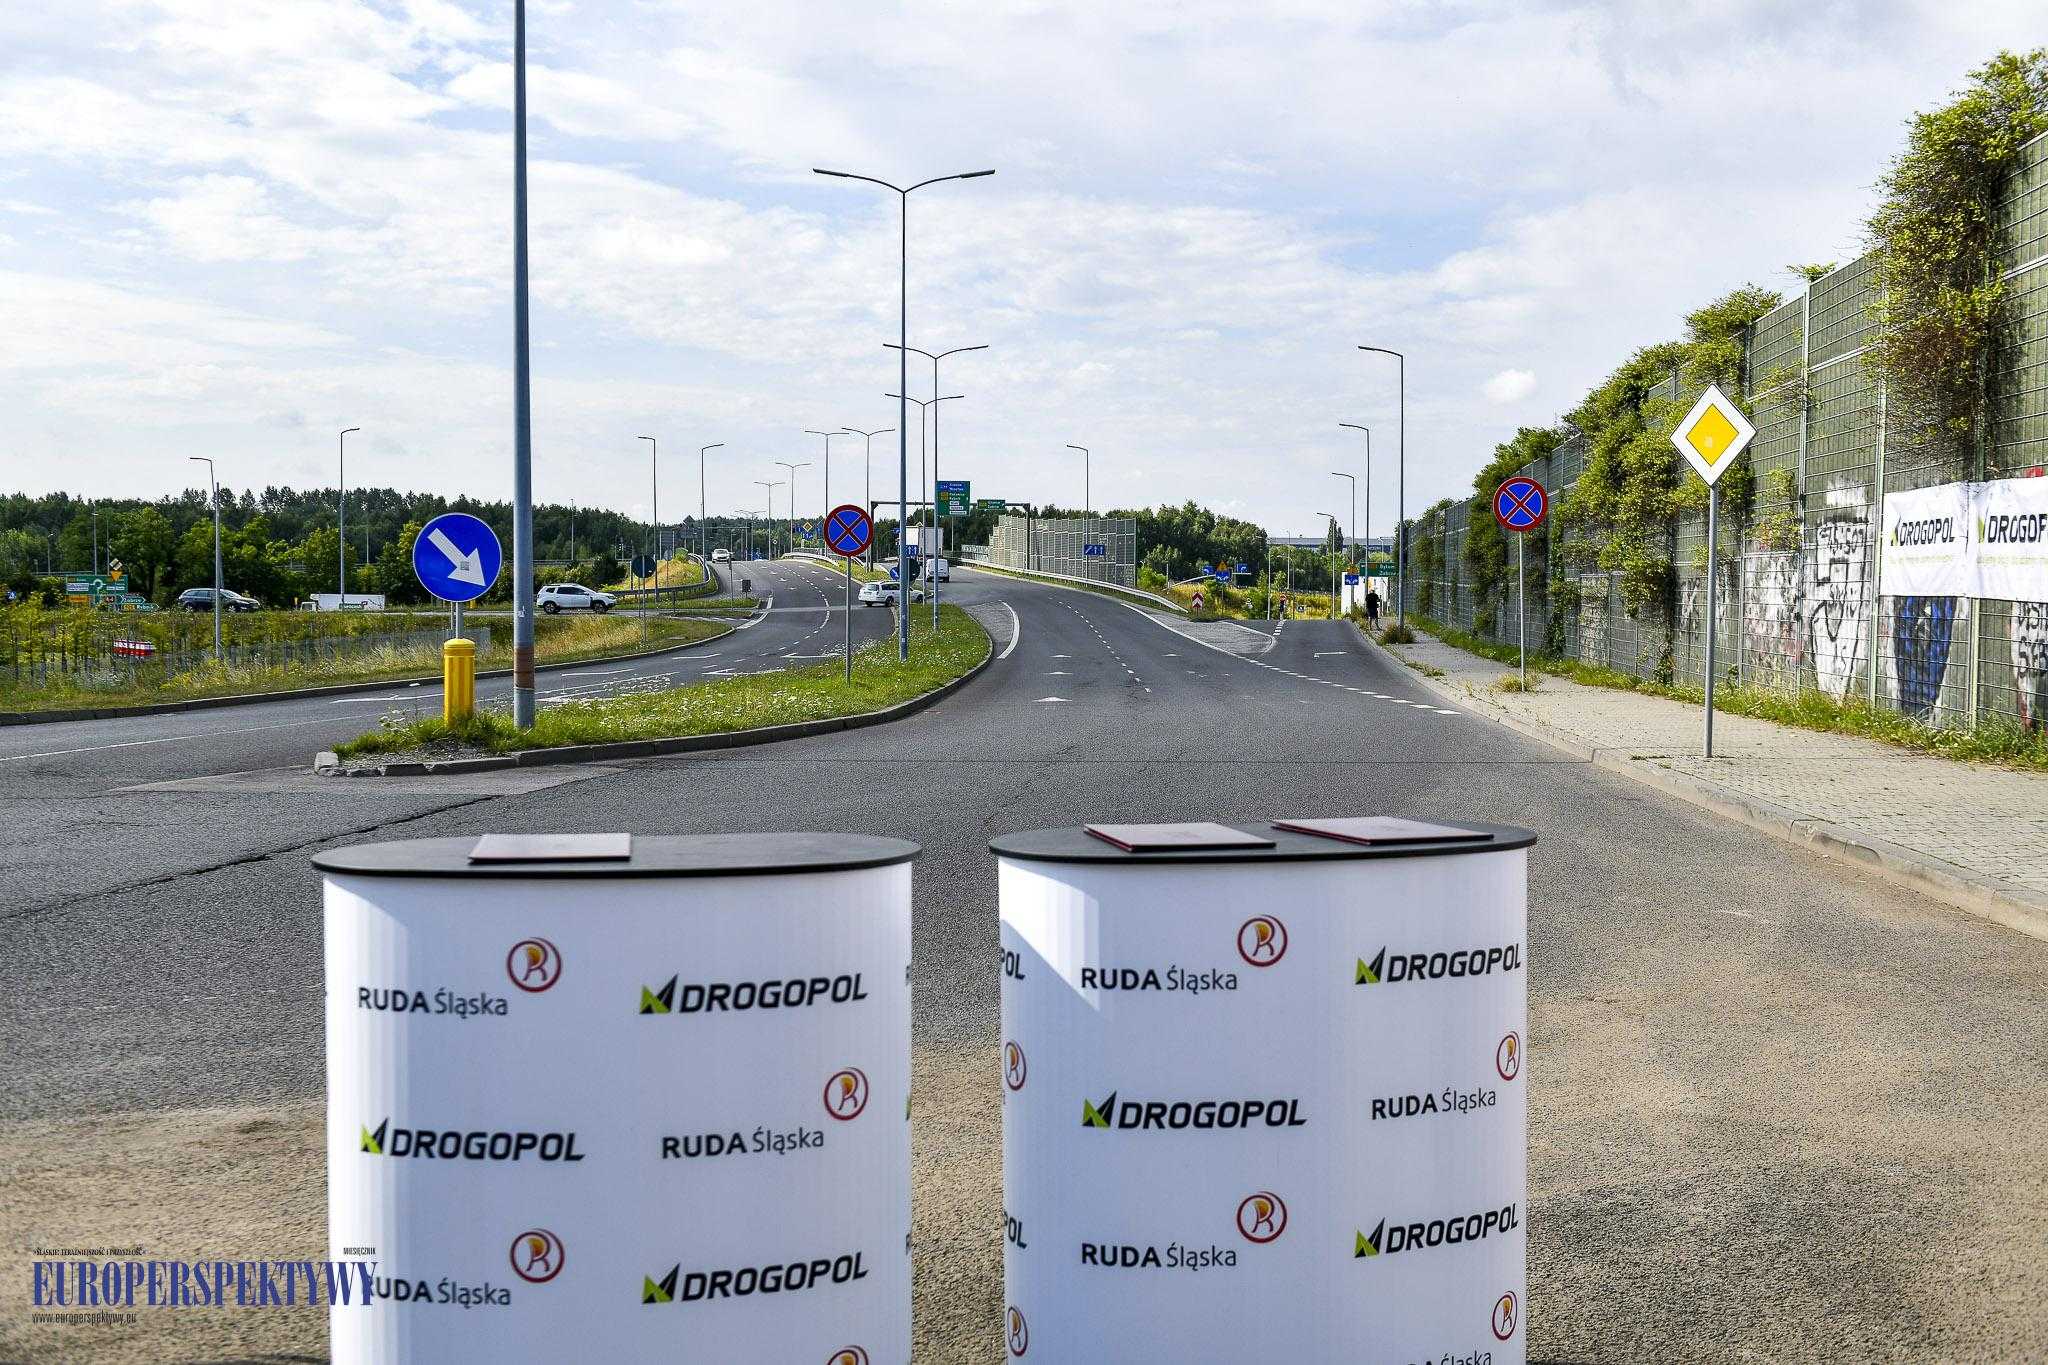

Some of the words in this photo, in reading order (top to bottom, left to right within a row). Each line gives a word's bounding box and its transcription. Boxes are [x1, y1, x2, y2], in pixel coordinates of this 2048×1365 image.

[1900, 516, 1955, 547] DROGOPOL
[1081, 968, 1162, 991] RUDA
[1166, 965, 1238, 994] Śląska
[1387, 943, 1522, 983] DROGOPOL
[358, 986, 430, 1013] RUDA
[433, 986, 509, 1020] Śląska
[680, 972, 868, 1014] DROGOPOL
[1118, 1099, 1308, 1130] DROGOPOL
[1371, 1093, 1439, 1121] RUDA
[1441, 1087, 1497, 1114] Śląska
[390, 1129, 586, 1162] DROGOPOL
[661, 1133, 748, 1160] RUDA
[752, 1126, 824, 1155] Śląska
[1386, 1203, 1520, 1255] DROGOPOL
[1081, 1243, 1162, 1268] RUDA
[1166, 1241, 1238, 1269] Śląska
[437, 1277, 512, 1309] Śląska
[681, 1251, 869, 1302] DROGOPOL
